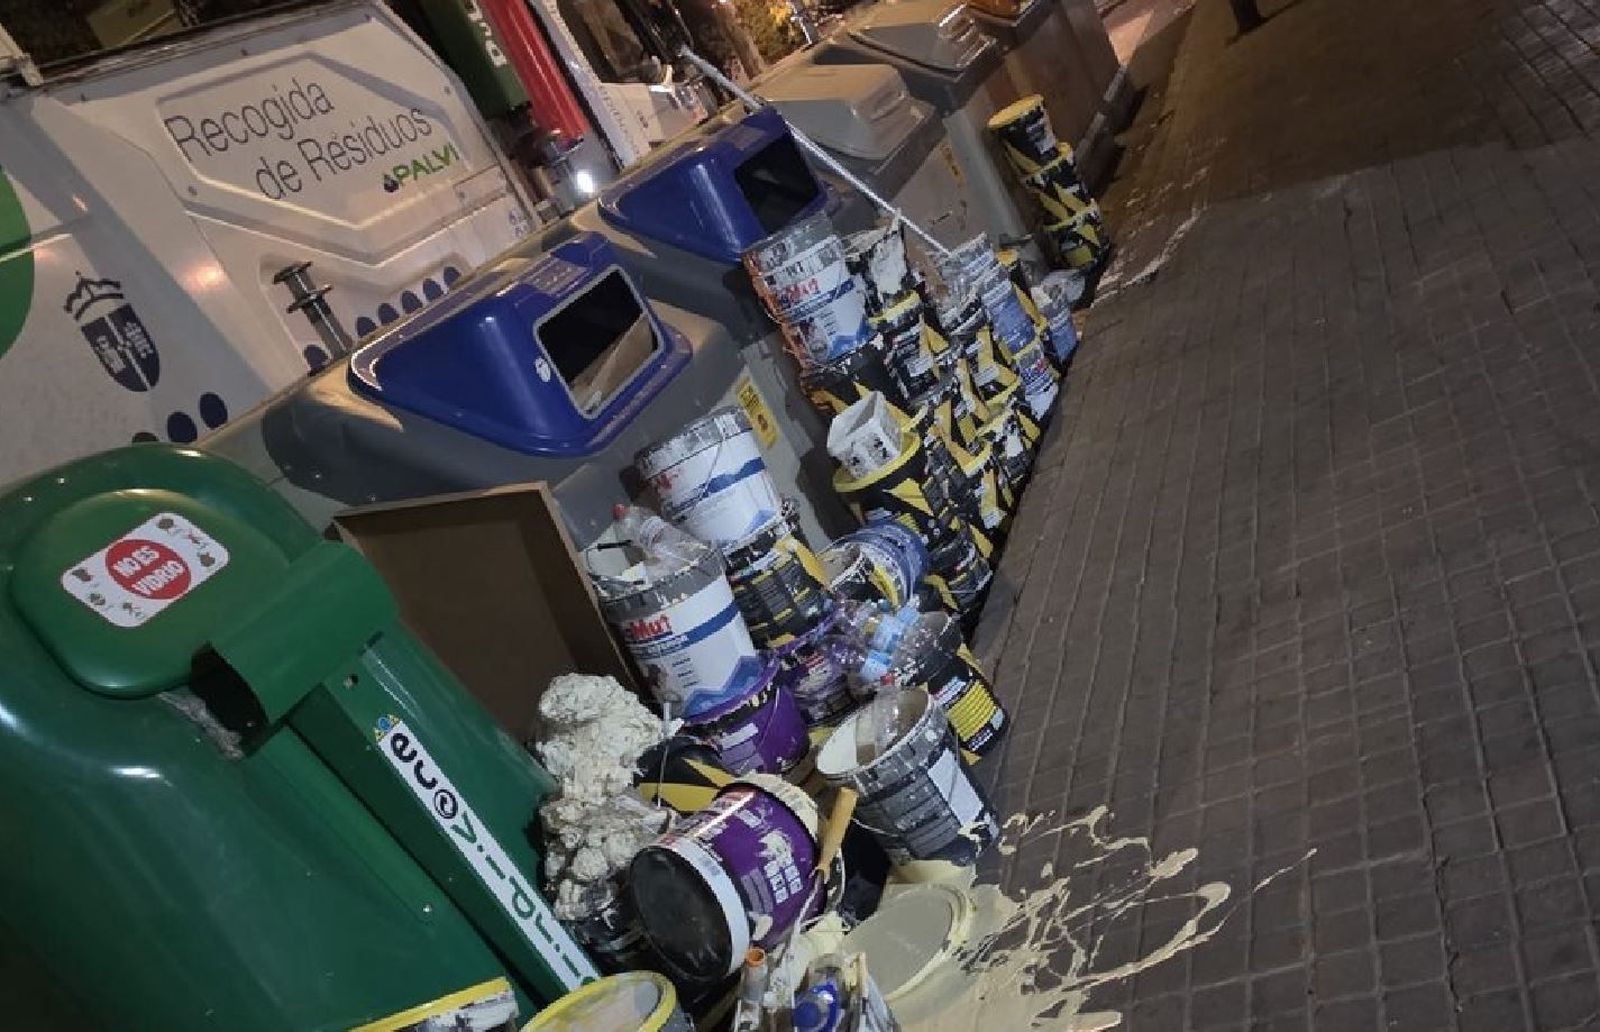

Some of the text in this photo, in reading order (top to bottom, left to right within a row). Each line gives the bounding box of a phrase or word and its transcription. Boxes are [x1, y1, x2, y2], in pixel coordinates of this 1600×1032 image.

[164, 77, 336, 162] Recogida
[255, 107, 432, 201] de Residuos
[392, 142, 460, 187] PALVI
[112, 545, 160, 578] NO ES
[131, 560, 185, 595] VIDRIO
